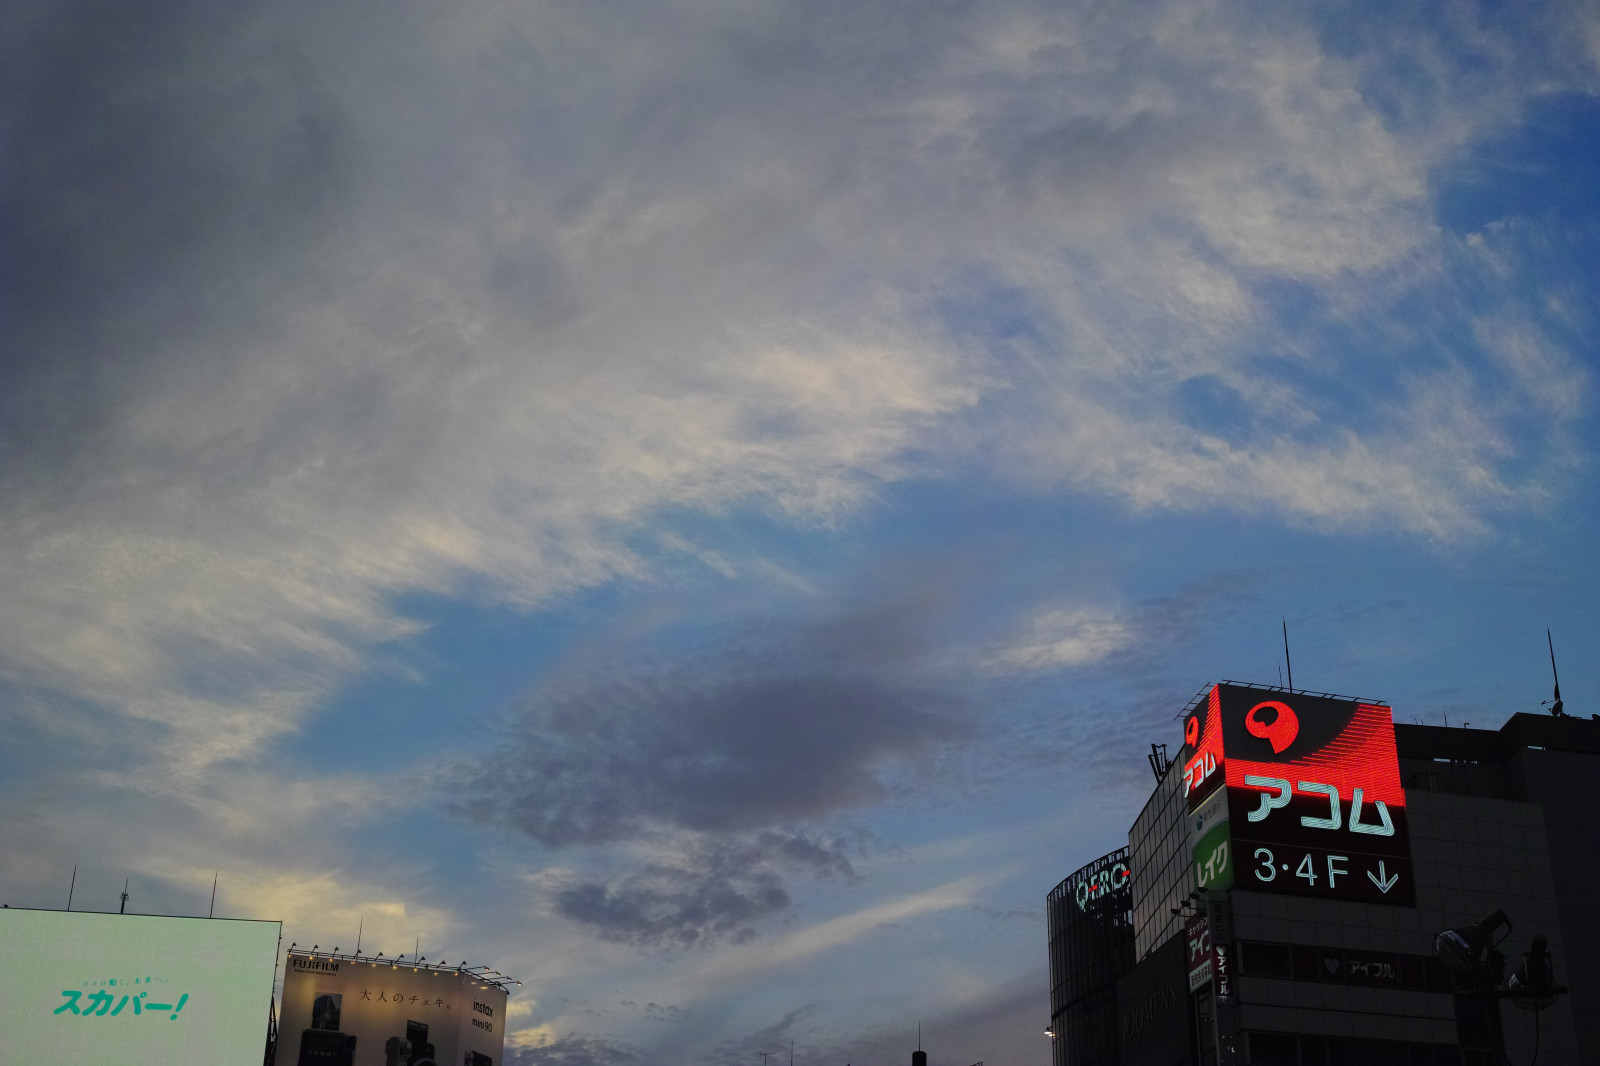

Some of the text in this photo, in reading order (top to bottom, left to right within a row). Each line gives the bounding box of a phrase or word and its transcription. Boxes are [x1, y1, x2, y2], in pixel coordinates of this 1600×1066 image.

[1183, 751, 1217, 799] アコム
[1244, 774, 1396, 838] アコム
[1197, 839, 1229, 888] レイク
[293, 959, 340, 972] FUJIFILM
[1217, 955, 1231, 995] アイフル
[1345, 957, 1394, 978] アイフル
[359, 989, 451, 1010] 大人のチェキ。
[473, 998, 494, 1018] instax
